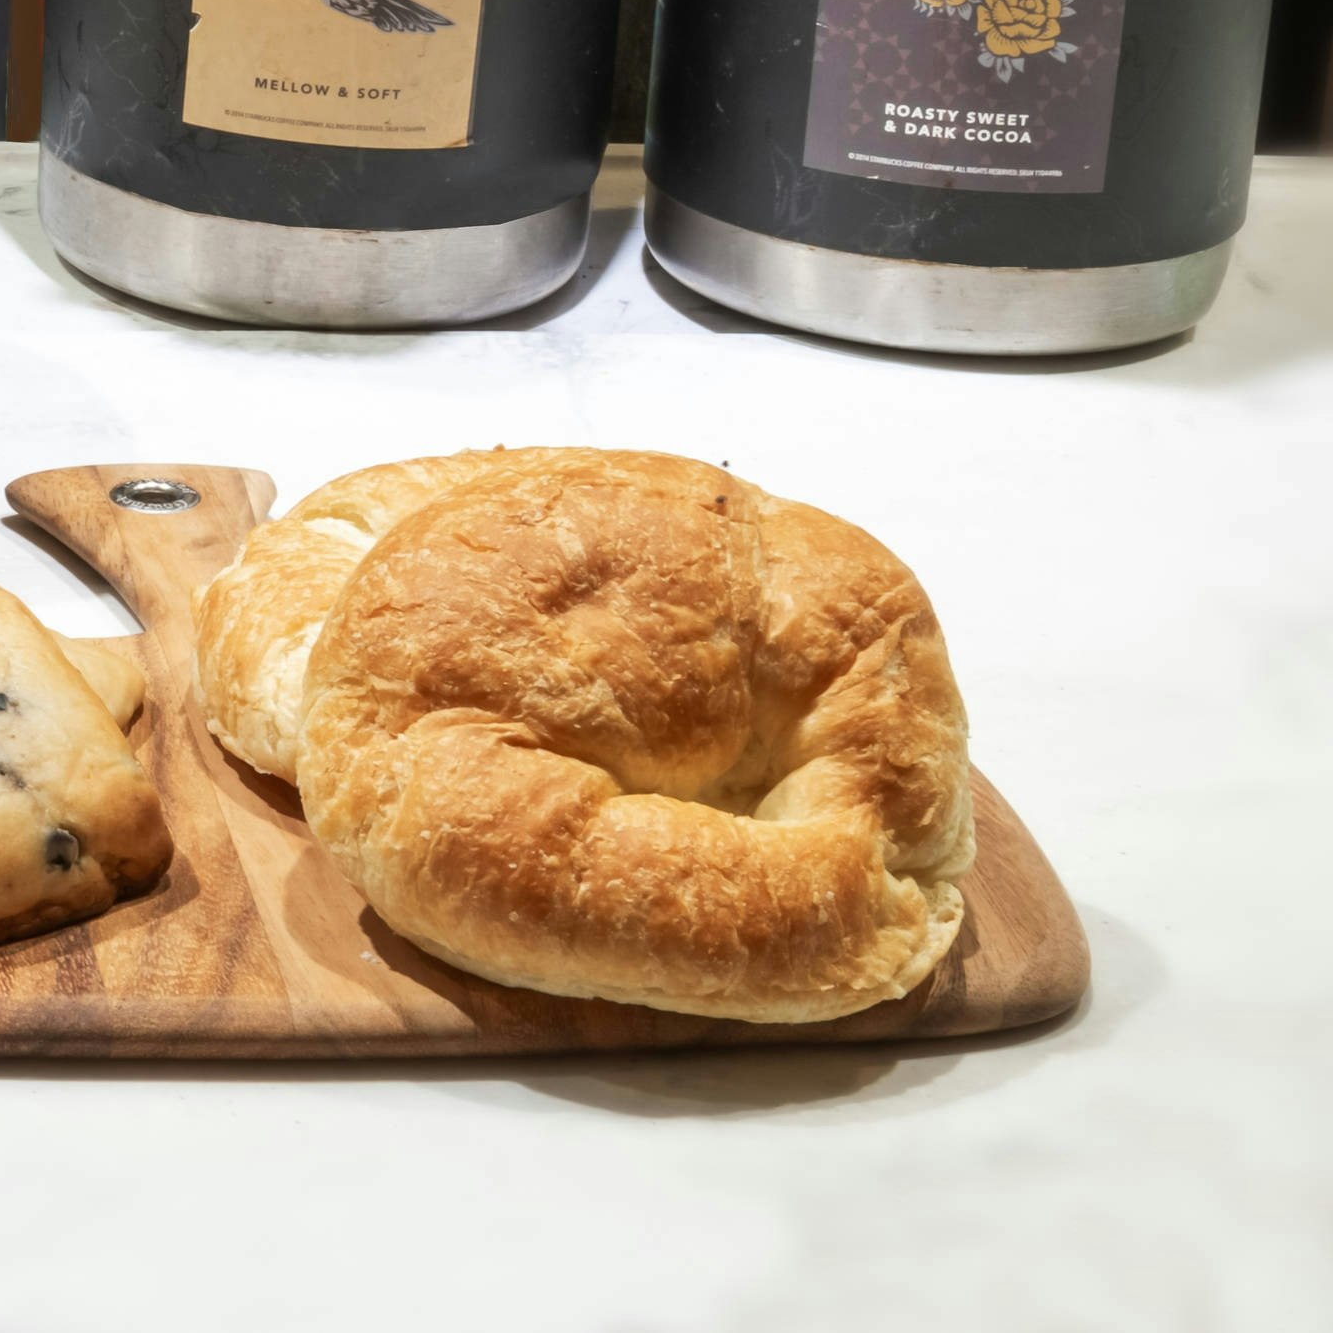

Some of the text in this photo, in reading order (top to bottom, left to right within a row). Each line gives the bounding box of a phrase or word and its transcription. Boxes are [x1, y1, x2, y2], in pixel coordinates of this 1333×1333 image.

[254, 77, 402, 100] MELLOW & SOFT
[884, 102, 1030, 127] ROASTY SWEET
[884, 119, 1032, 143] & DARK COCOA
